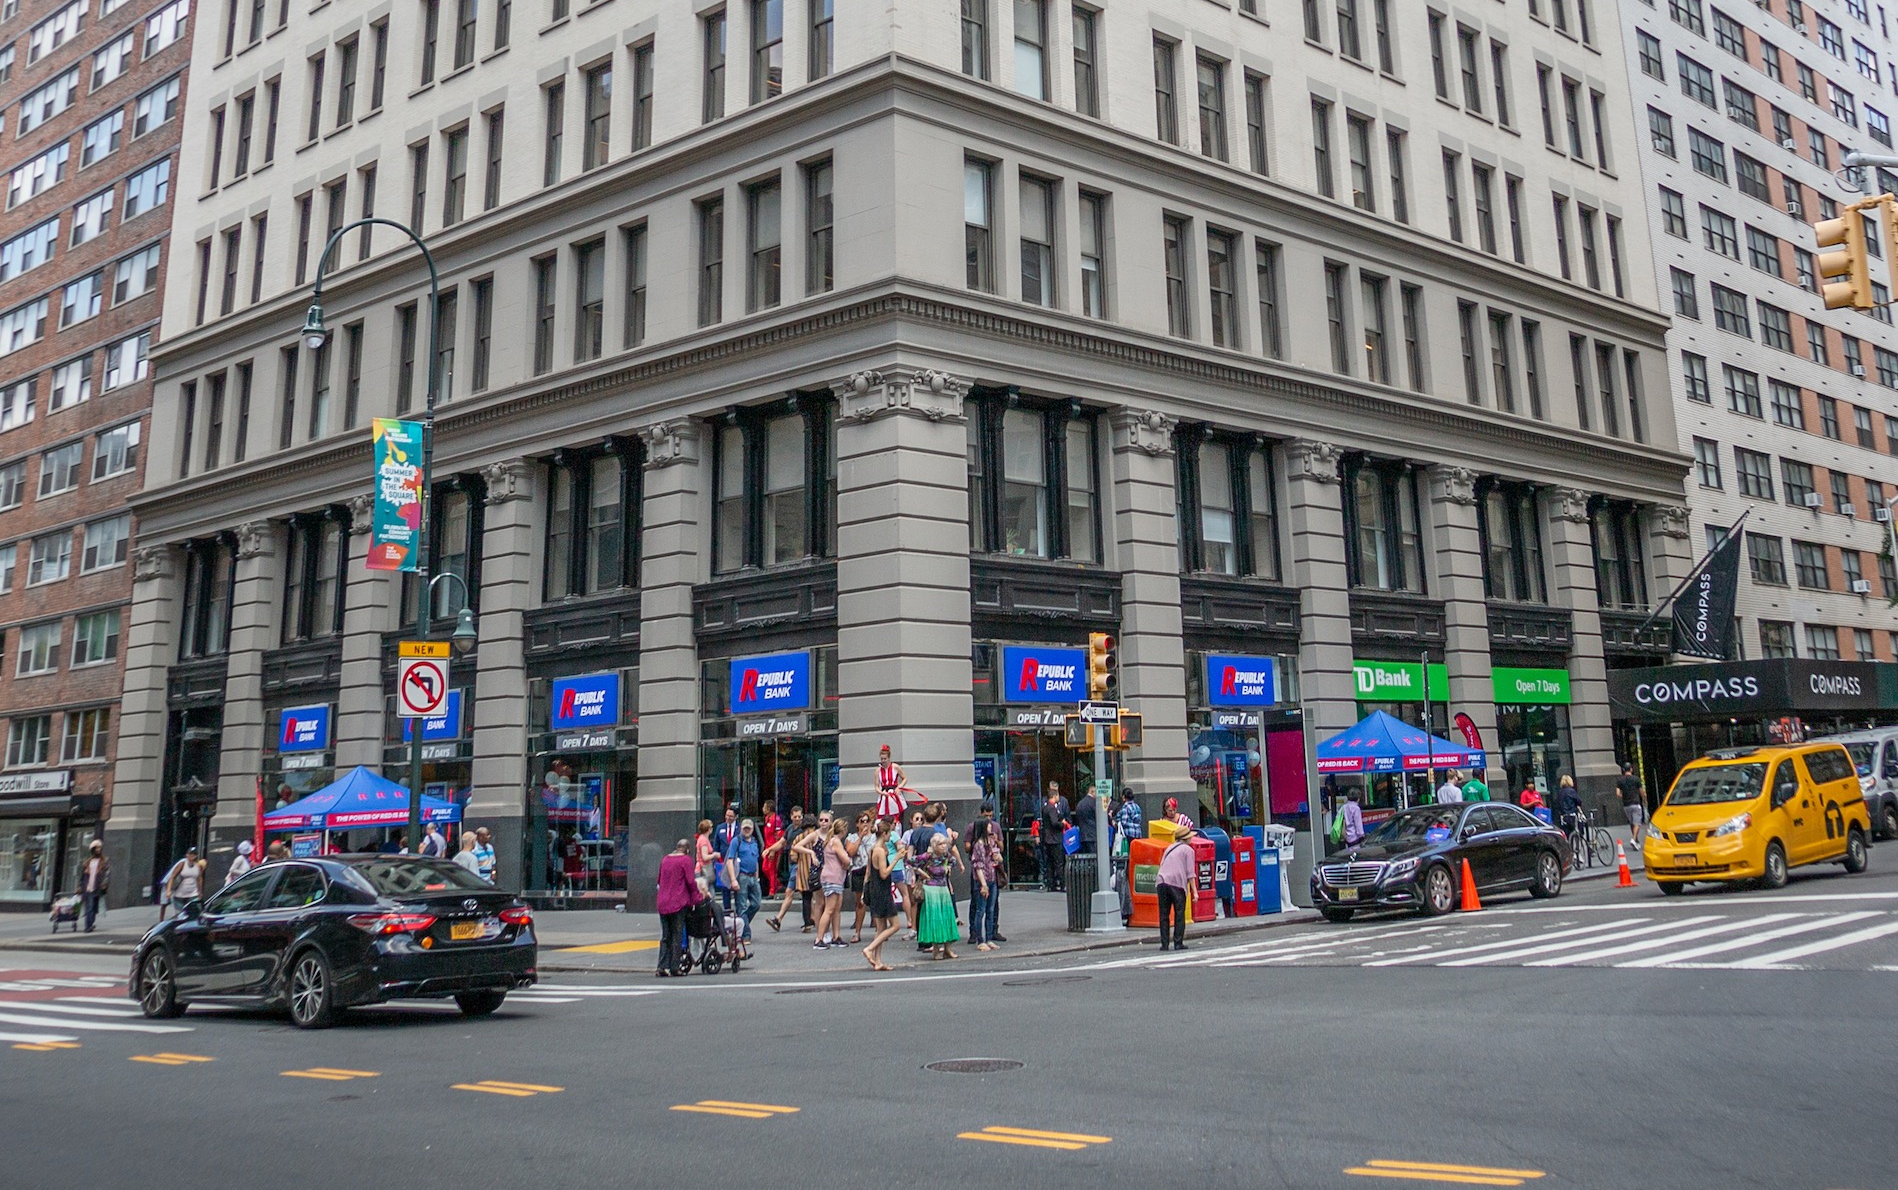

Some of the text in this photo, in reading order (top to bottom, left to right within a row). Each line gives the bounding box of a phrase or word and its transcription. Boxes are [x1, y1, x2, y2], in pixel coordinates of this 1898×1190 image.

[385, 468, 413, 476] SUMMER
[389, 492, 414, 500] SQUARE
[1696, 573, 1711, 642] COMPASS
[414, 645, 434, 654] NEW
[1020, 658, 1075, 690] REPUBLIC
[1221, 666, 1266, 695] REPUBLIC
[1353, 667, 1411, 692] TD Bank
[739, 668, 795, 702] REPUBLIC
[1046, 680, 1073, 691] BANK
[1242, 686, 1263, 695] BANK
[1516, 679, 1560, 695] Open 7 Days
[1635, 676, 1758, 703] COMPASS
[1810, 673, 1861, 696] COMPASS
[764, 686, 791, 699] BANK
[559, 688, 606, 719] REPUBLIC
[580, 705, 602, 716] BANK
[1086, 709, 1114, 717] ONE WAY
[1017, 710, 1065, 725] OPEN 7 DA
[1219, 713, 1259, 725] OPEN 7 DA
[284, 717, 319, 744] REPUBLIC
[426, 720, 446, 730] BANK
[743, 719, 799, 734] OPEN 7 DAYS
[299, 732, 316, 742] BANK
[562, 734, 608, 748] OPEN 7 DAYS
[427, 745, 435, 758] 7
[435, 748, 450, 757] DAYS
[0, 775, 31, 790] oodwill
[336, 815, 349, 823] THE
[349, 814, 372, 822] POWER
[1793, 817, 1804, 827] NYC
